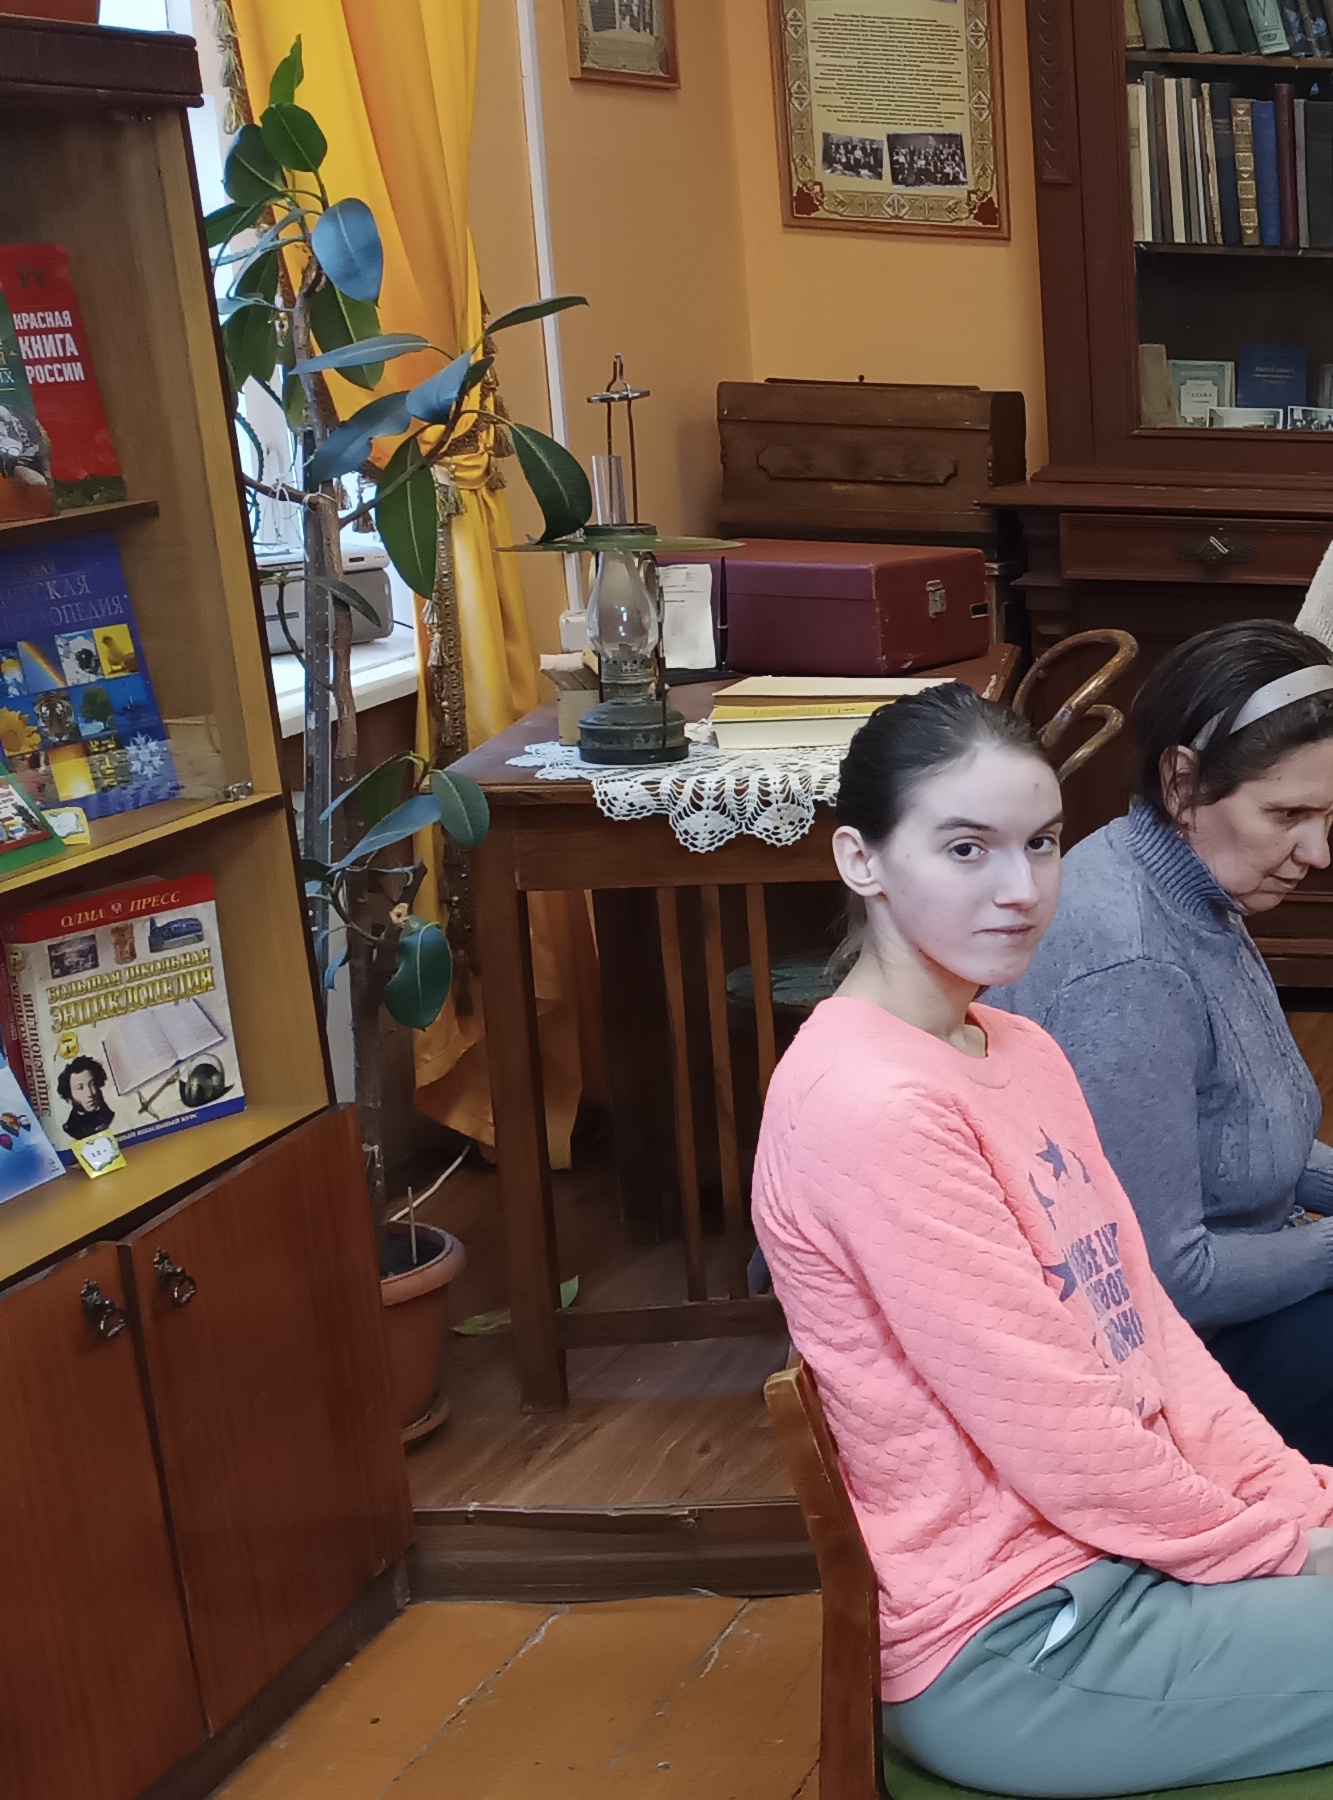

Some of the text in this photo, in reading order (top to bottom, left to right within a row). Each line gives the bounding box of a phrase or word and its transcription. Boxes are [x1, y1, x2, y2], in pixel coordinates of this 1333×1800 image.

[12, 310, 72, 330] КРАСНАЯ
[18, 333, 79, 359] КНИГА
[25, 362, 85, 384] РОССИИ
[129, 891, 181, 911] ПРЕСС
[50, 966, 216, 1034] ЭНЦИКЛОПЕДИЯ
